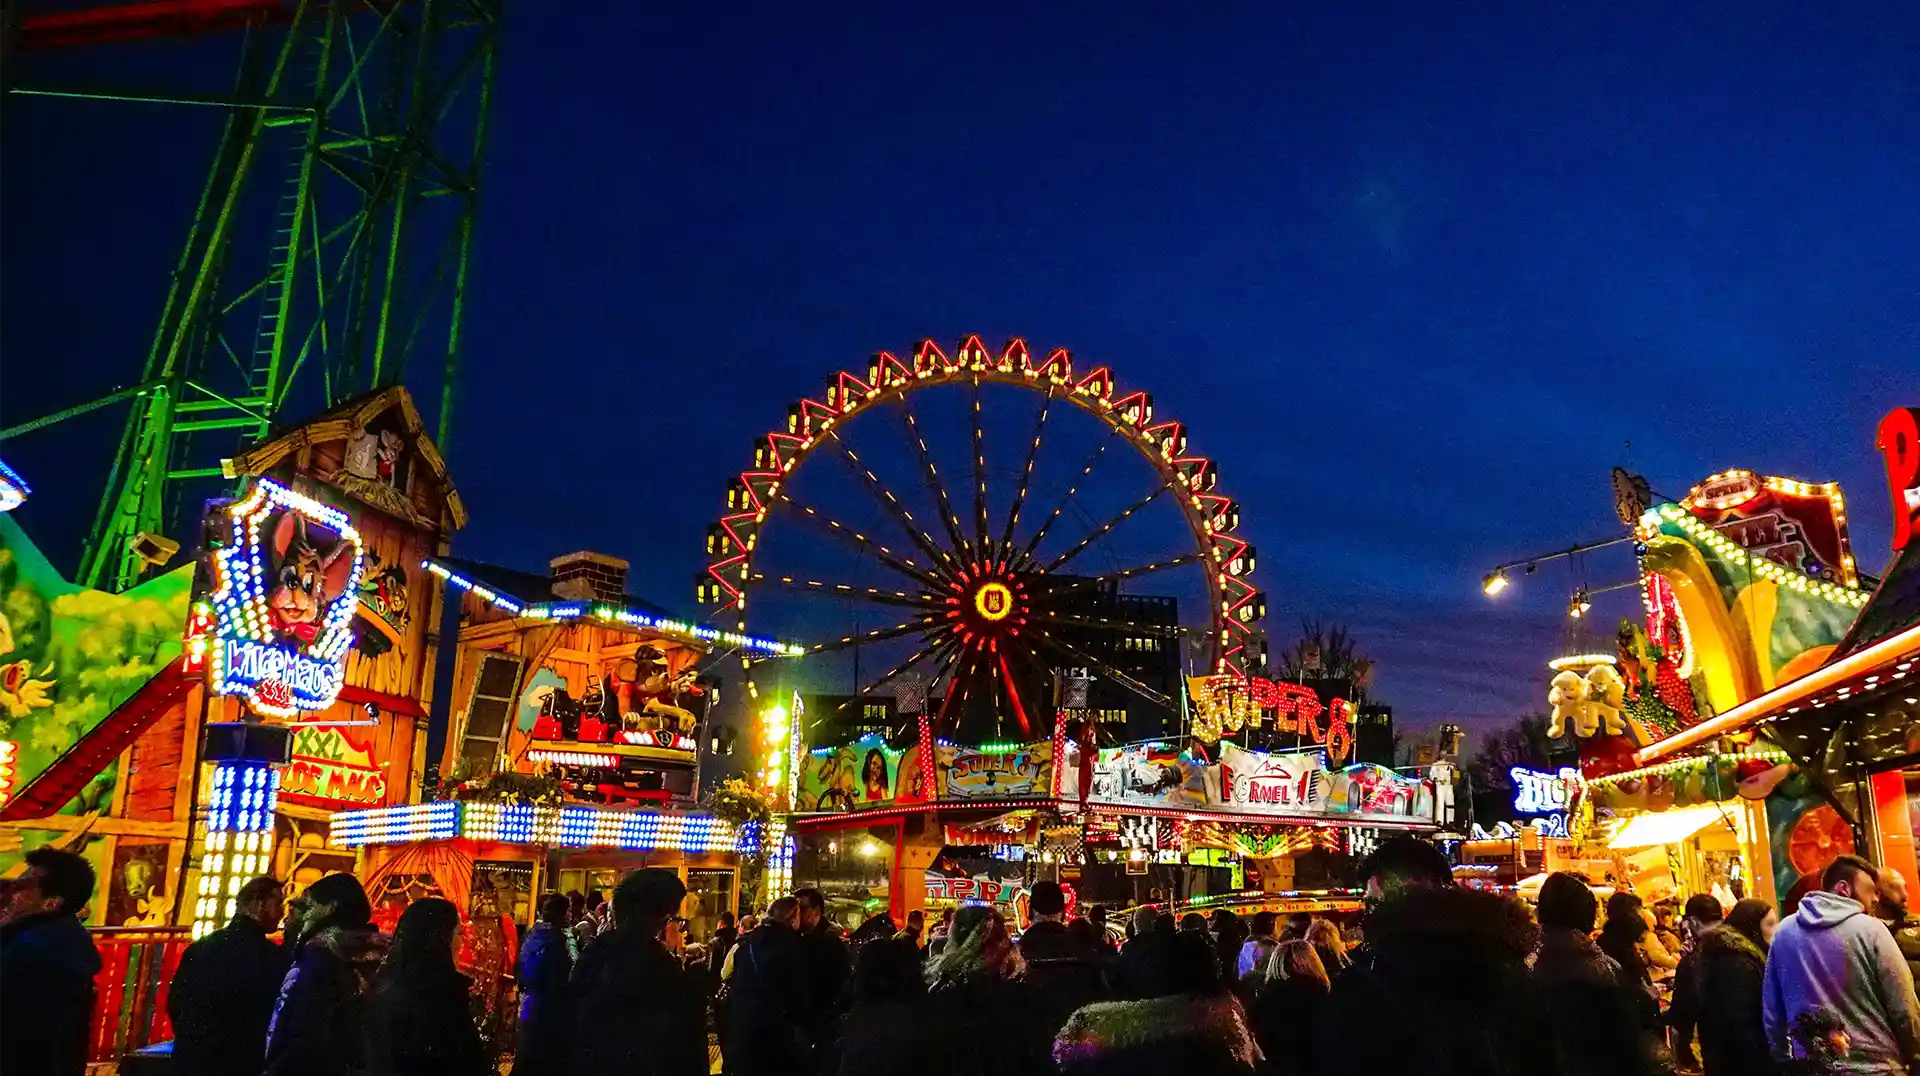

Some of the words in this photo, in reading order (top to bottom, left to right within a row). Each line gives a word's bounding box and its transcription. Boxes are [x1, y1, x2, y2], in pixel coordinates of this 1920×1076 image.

[1191, 674, 1325, 746] SUPER
[1326, 696, 1351, 761] 8
[296, 728, 344, 760] XXL
[1221, 763, 1290, 804] FORMEL
